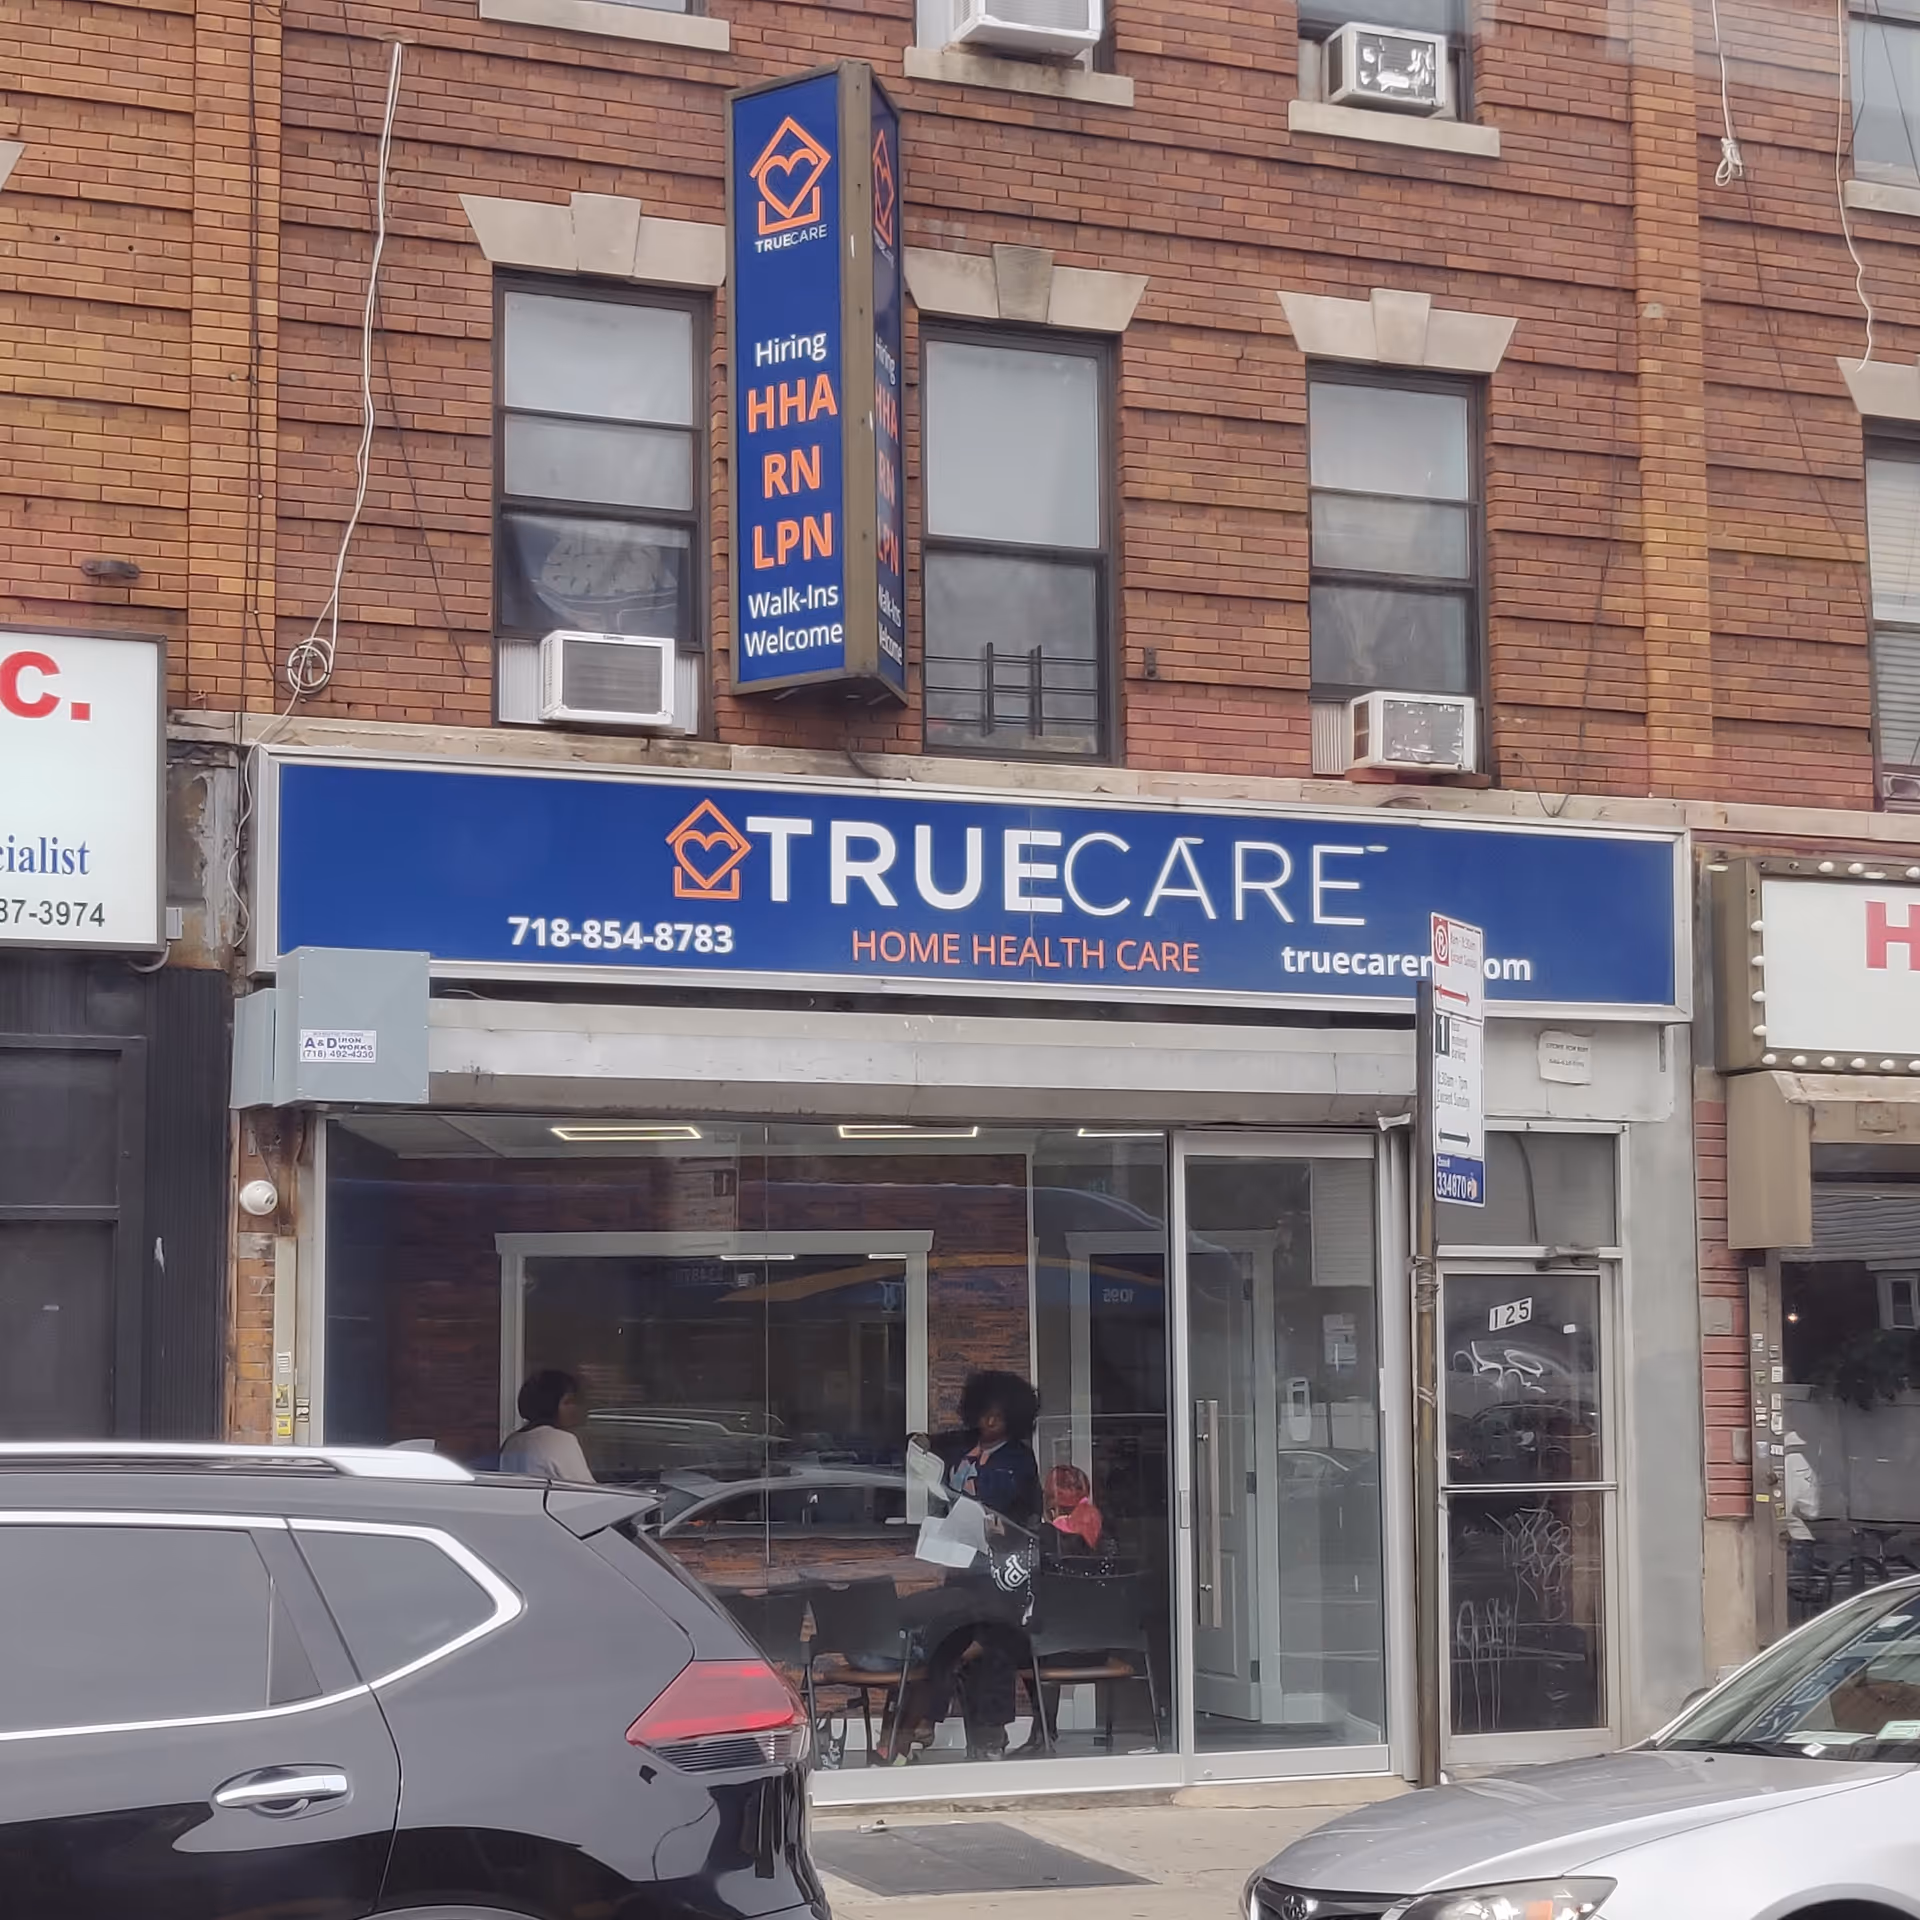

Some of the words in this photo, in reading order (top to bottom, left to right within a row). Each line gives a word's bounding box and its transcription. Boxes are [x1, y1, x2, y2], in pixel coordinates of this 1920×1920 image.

[754, 224, 827, 253] TRUECARE
[755, 332, 827, 367] Hiring
[748, 373, 838, 433] HHA
[763, 445, 821, 498] RN
[753, 512, 833, 570] LPN
[748, 584, 839, 619] Walk-Ins
[744, 623, 843, 658] Welcome
[0, 834, 91, 875] ialist
[746, 816, 1366, 927] TRUECARE
[507, 915, 734, 953] 718-854-8783
[852, 930, 961, 965] HOME
[972, 933, 1105, 970] HEALTH
[1116, 939, 1200, 973] CARE
[304, 1037, 316, 1049] A
[327, 1037, 338, 1049] D
[1438, 1171, 1467, 1199] 334870
[1494, 1300, 1530, 1329] 125
